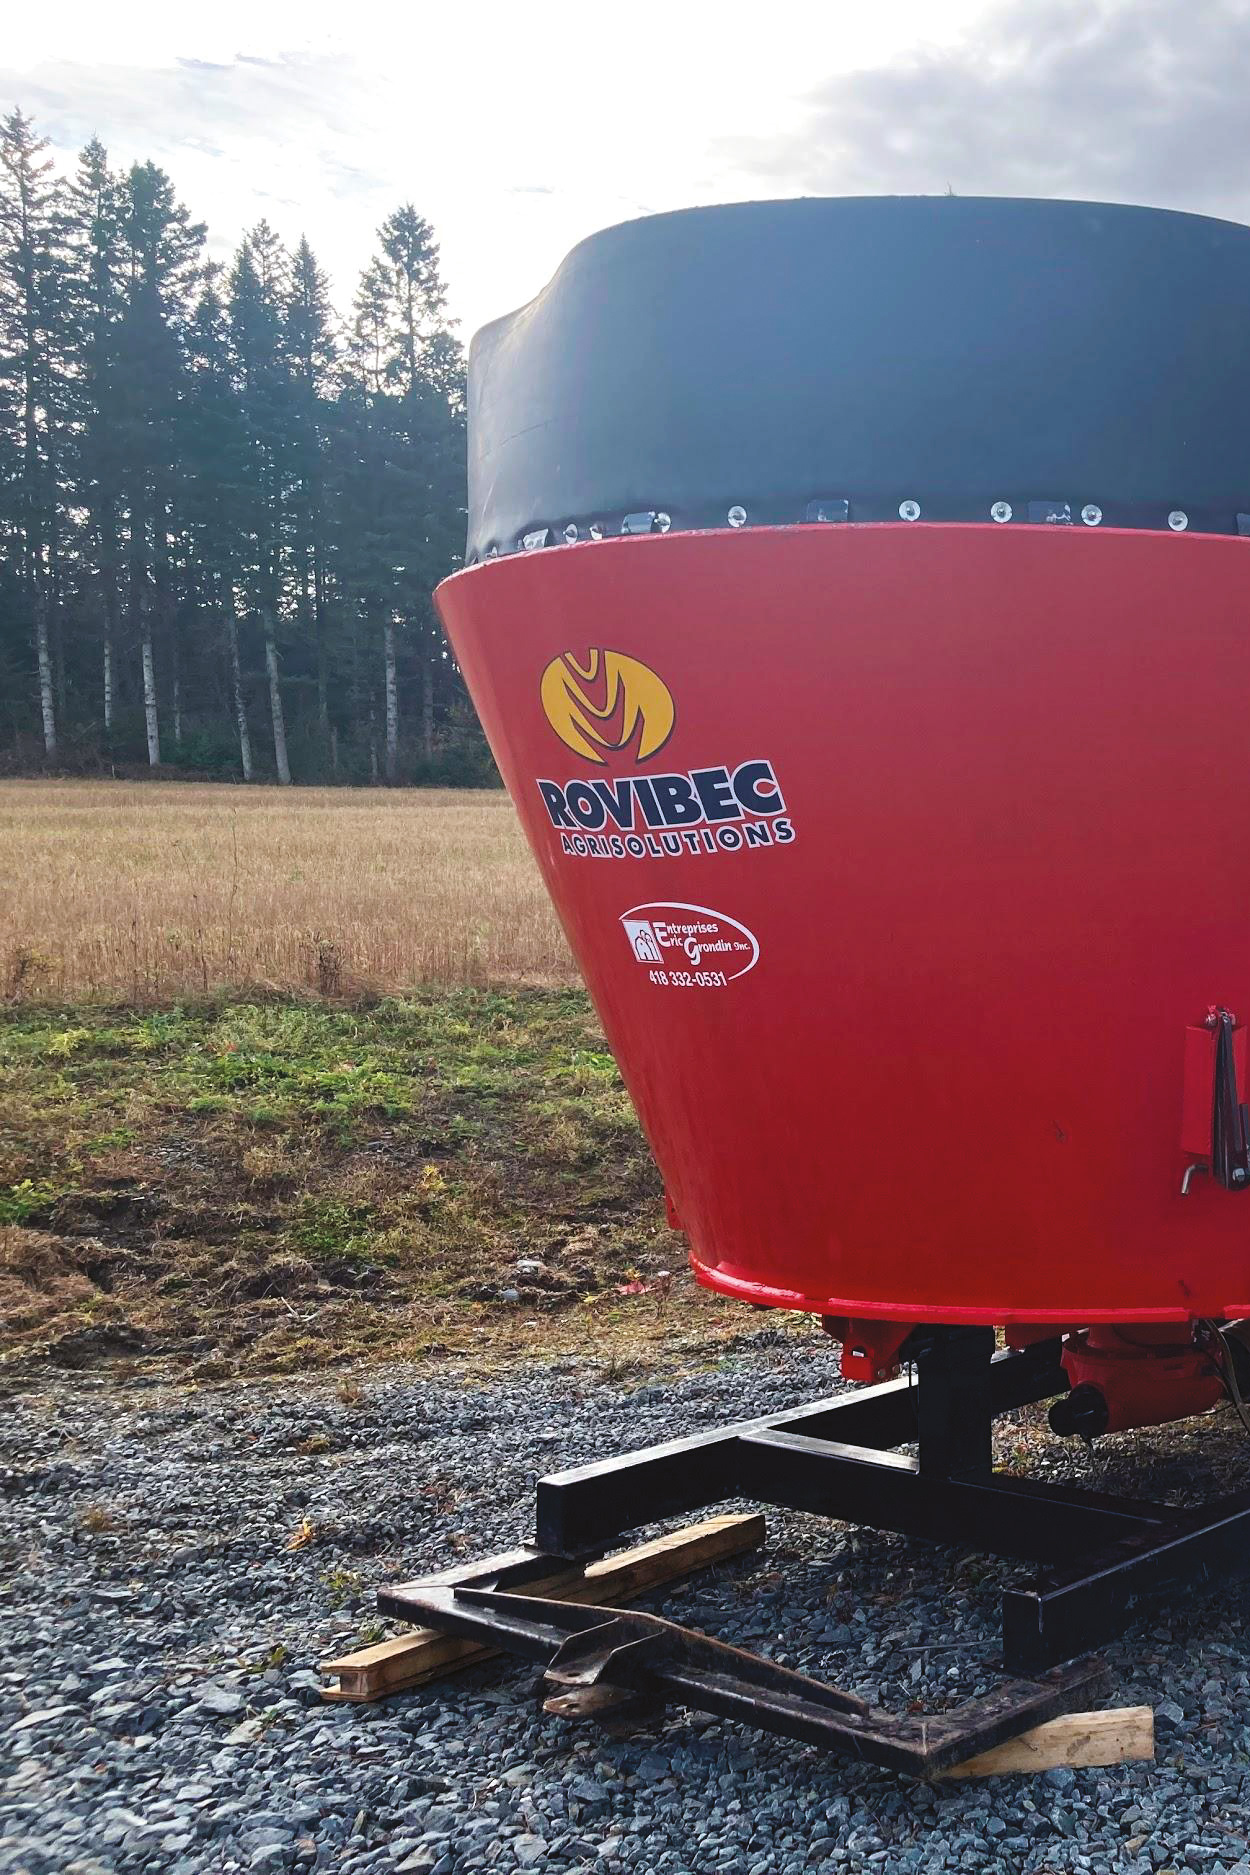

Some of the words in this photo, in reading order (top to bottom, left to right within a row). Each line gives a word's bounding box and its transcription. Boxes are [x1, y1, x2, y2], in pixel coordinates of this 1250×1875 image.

[536, 760, 787, 831] ROVIBEC
[561, 818, 796, 858] AGRISOLUTIONS
[652, 921, 719, 938] Entreprises
[655, 932, 684, 948] Eric
[649, 970, 669, 986] 418
[668, 970, 727, 987] 332-0531
